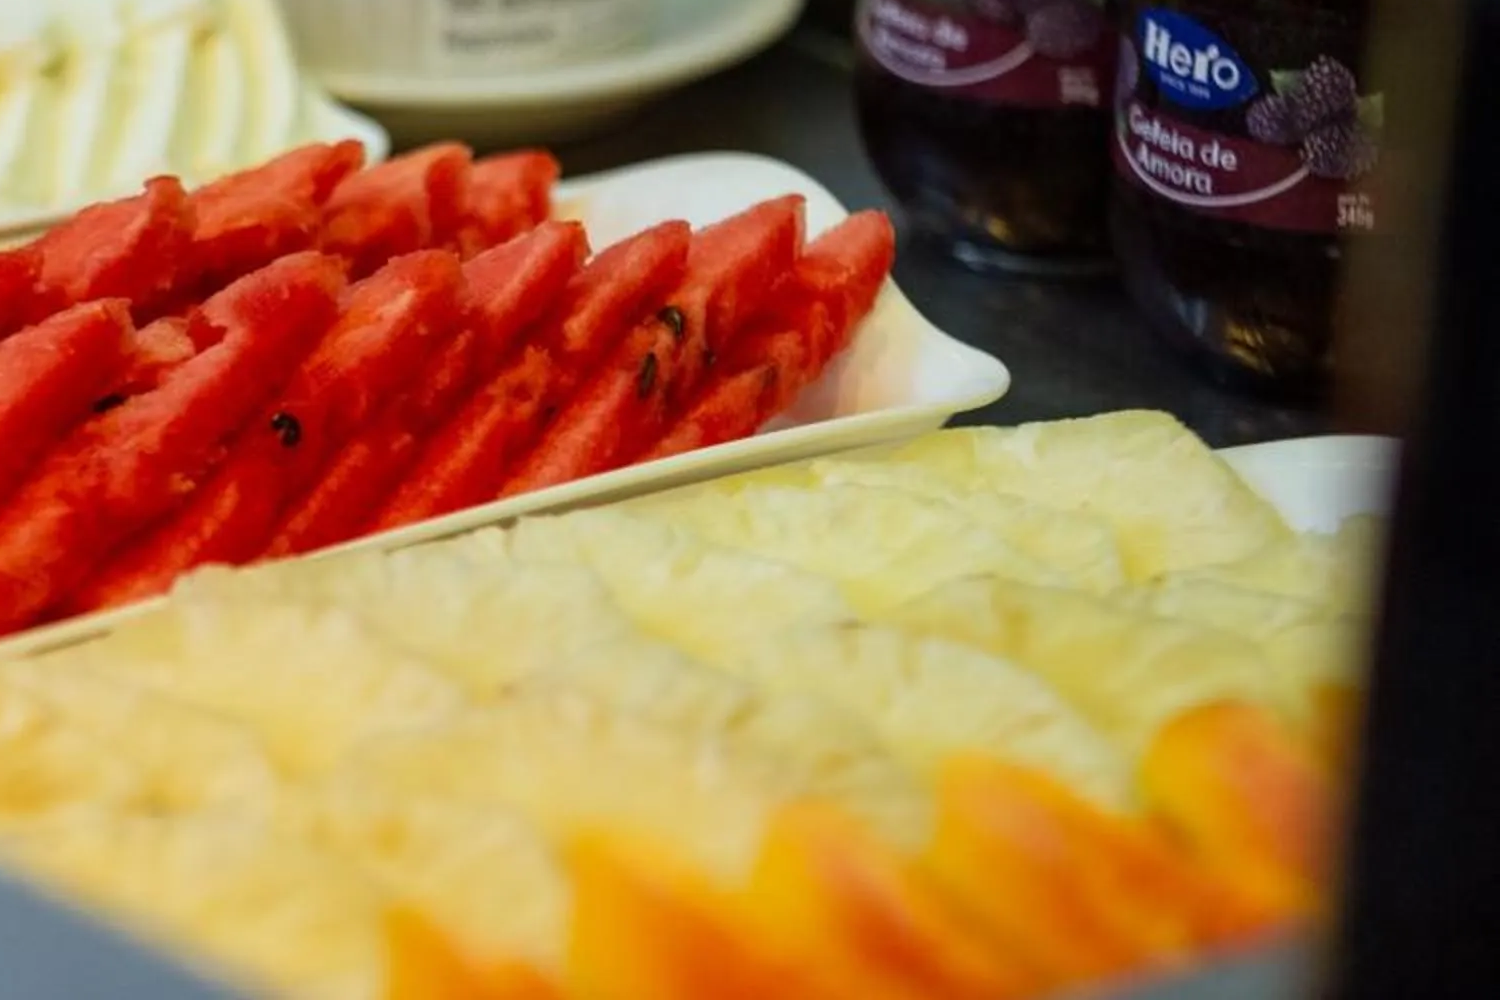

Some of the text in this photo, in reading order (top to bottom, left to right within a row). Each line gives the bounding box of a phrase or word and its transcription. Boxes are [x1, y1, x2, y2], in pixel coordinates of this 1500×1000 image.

[1144, 18, 1240, 91] Hero
[1129, 103, 1238, 172] Geleia de
[1137, 141, 1213, 195] Amora
